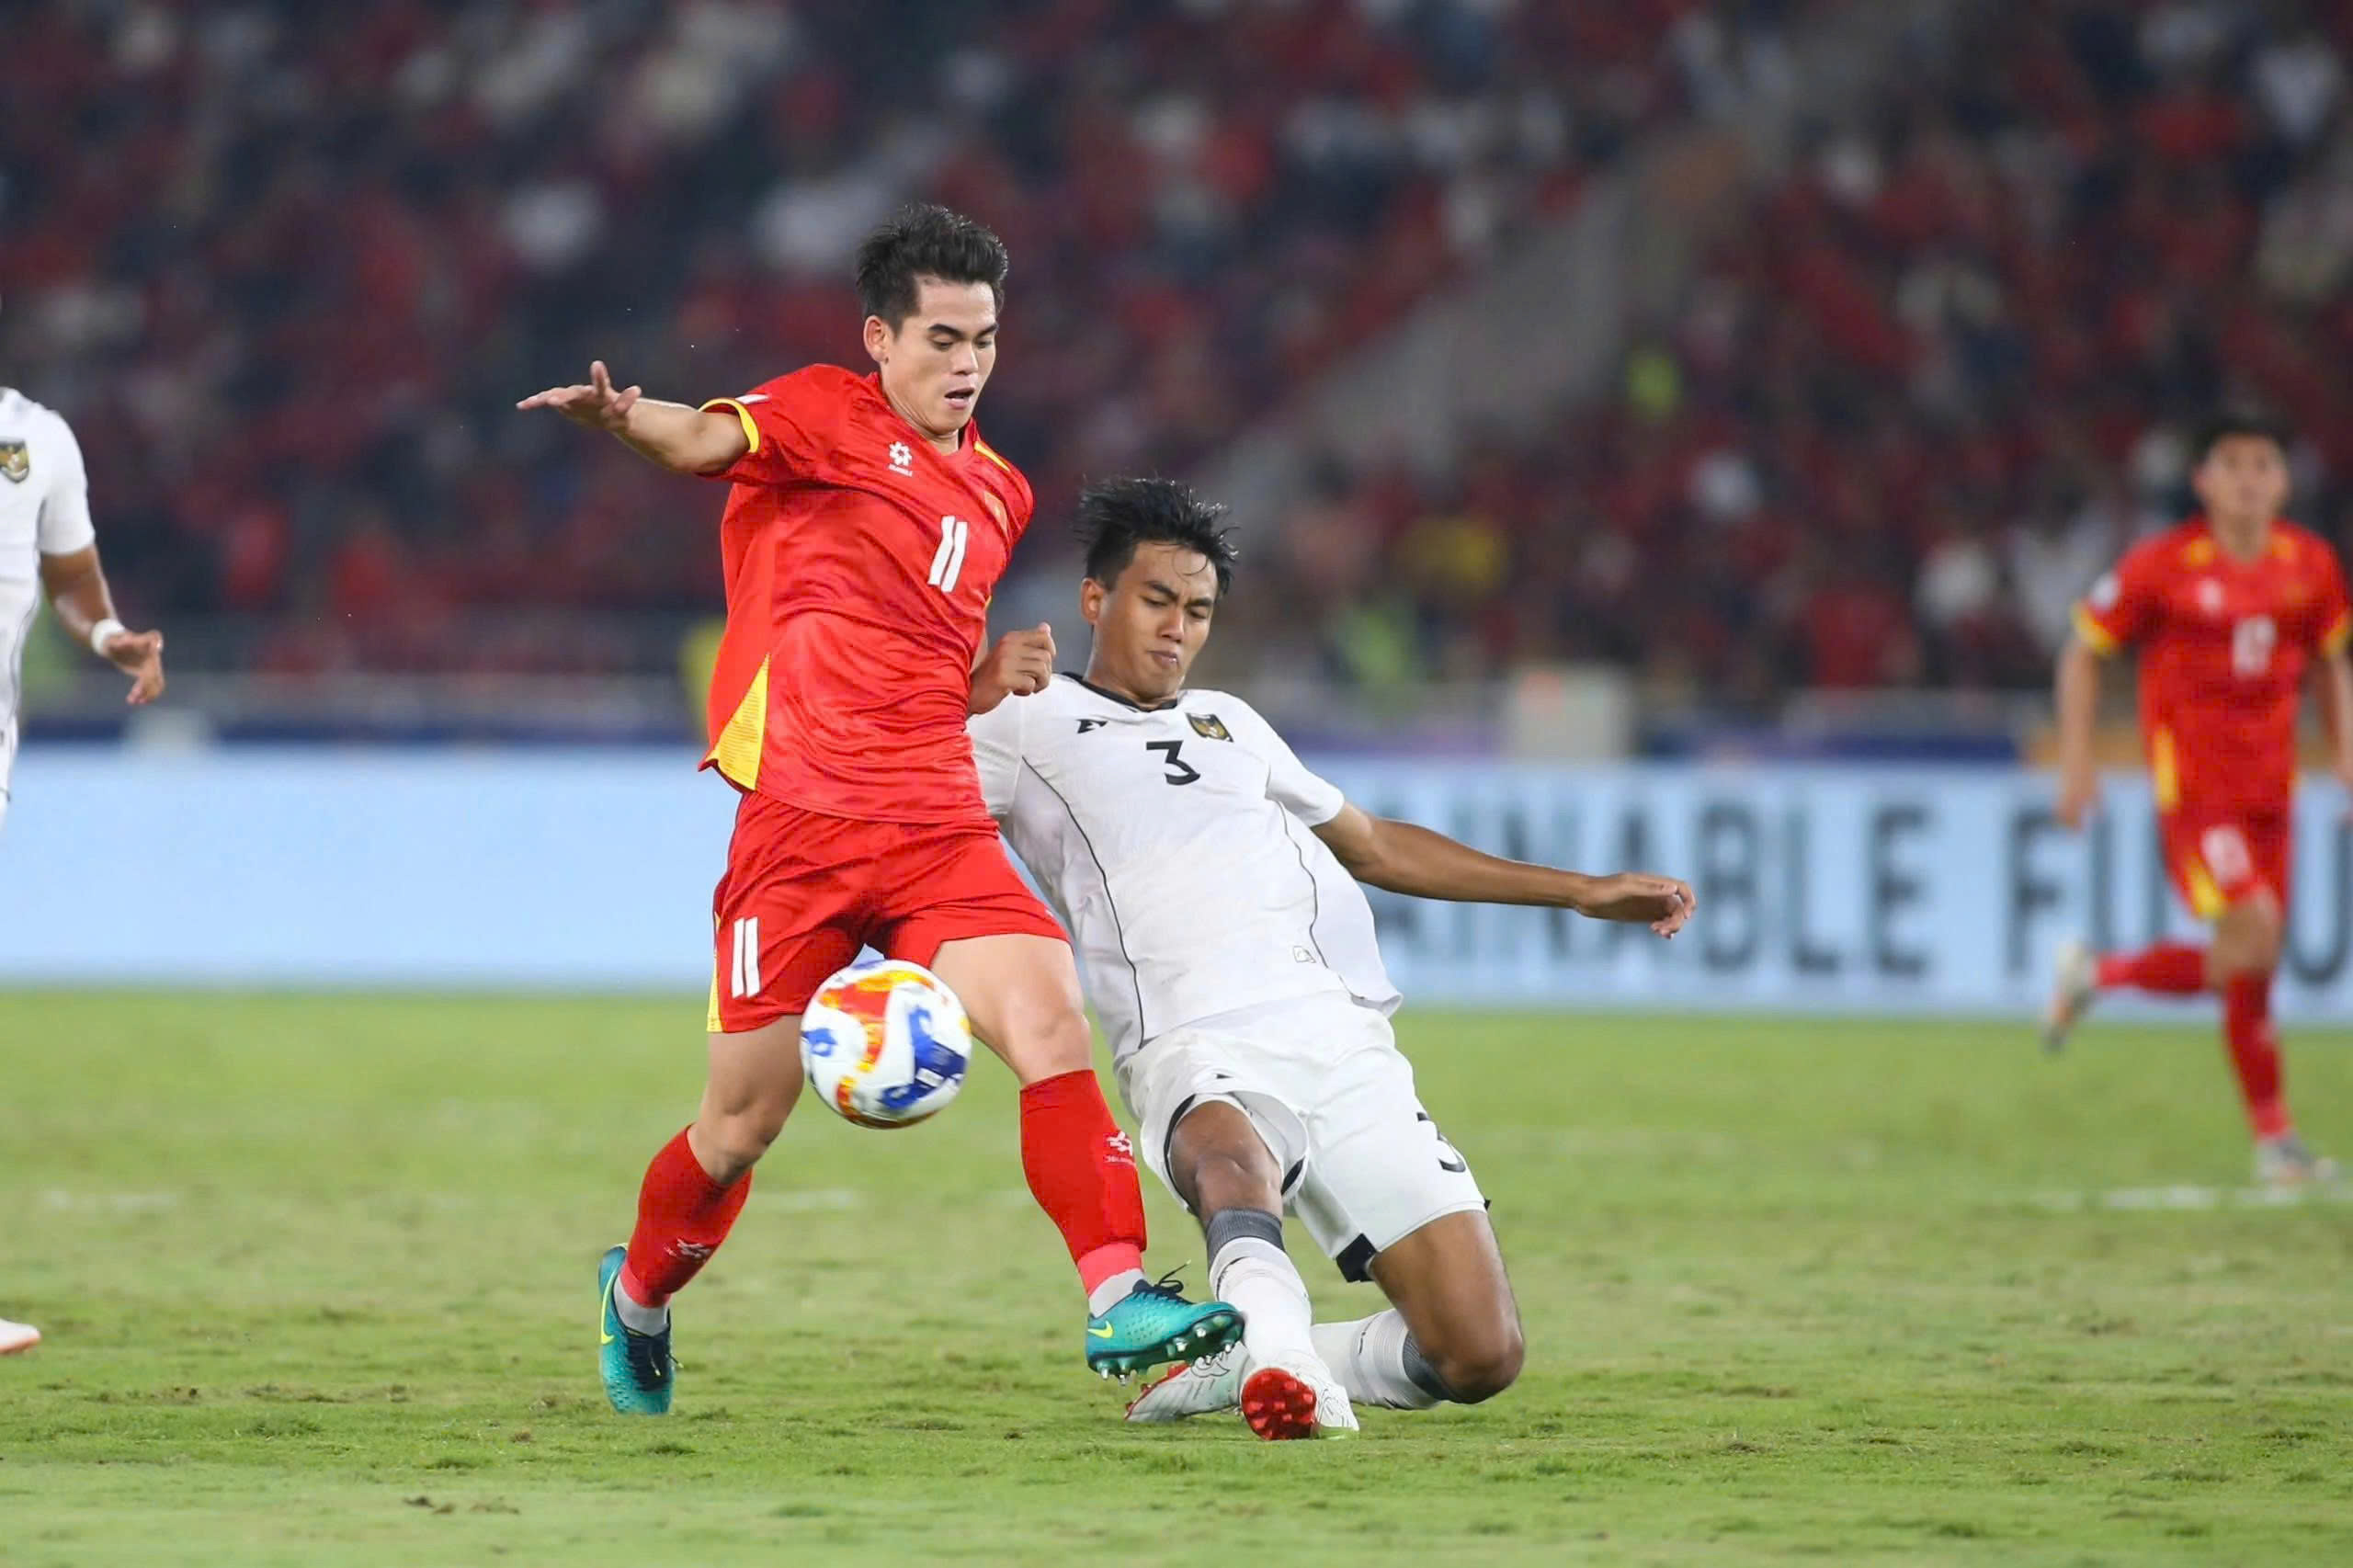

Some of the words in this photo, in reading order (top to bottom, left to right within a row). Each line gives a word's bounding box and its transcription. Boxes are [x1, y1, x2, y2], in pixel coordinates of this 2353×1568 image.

[927, 516, 968, 593] 11
[1146, 740, 1200, 785] 3
[732, 916, 761, 999] 11
[1416, 1111, 1467, 1173] 3
